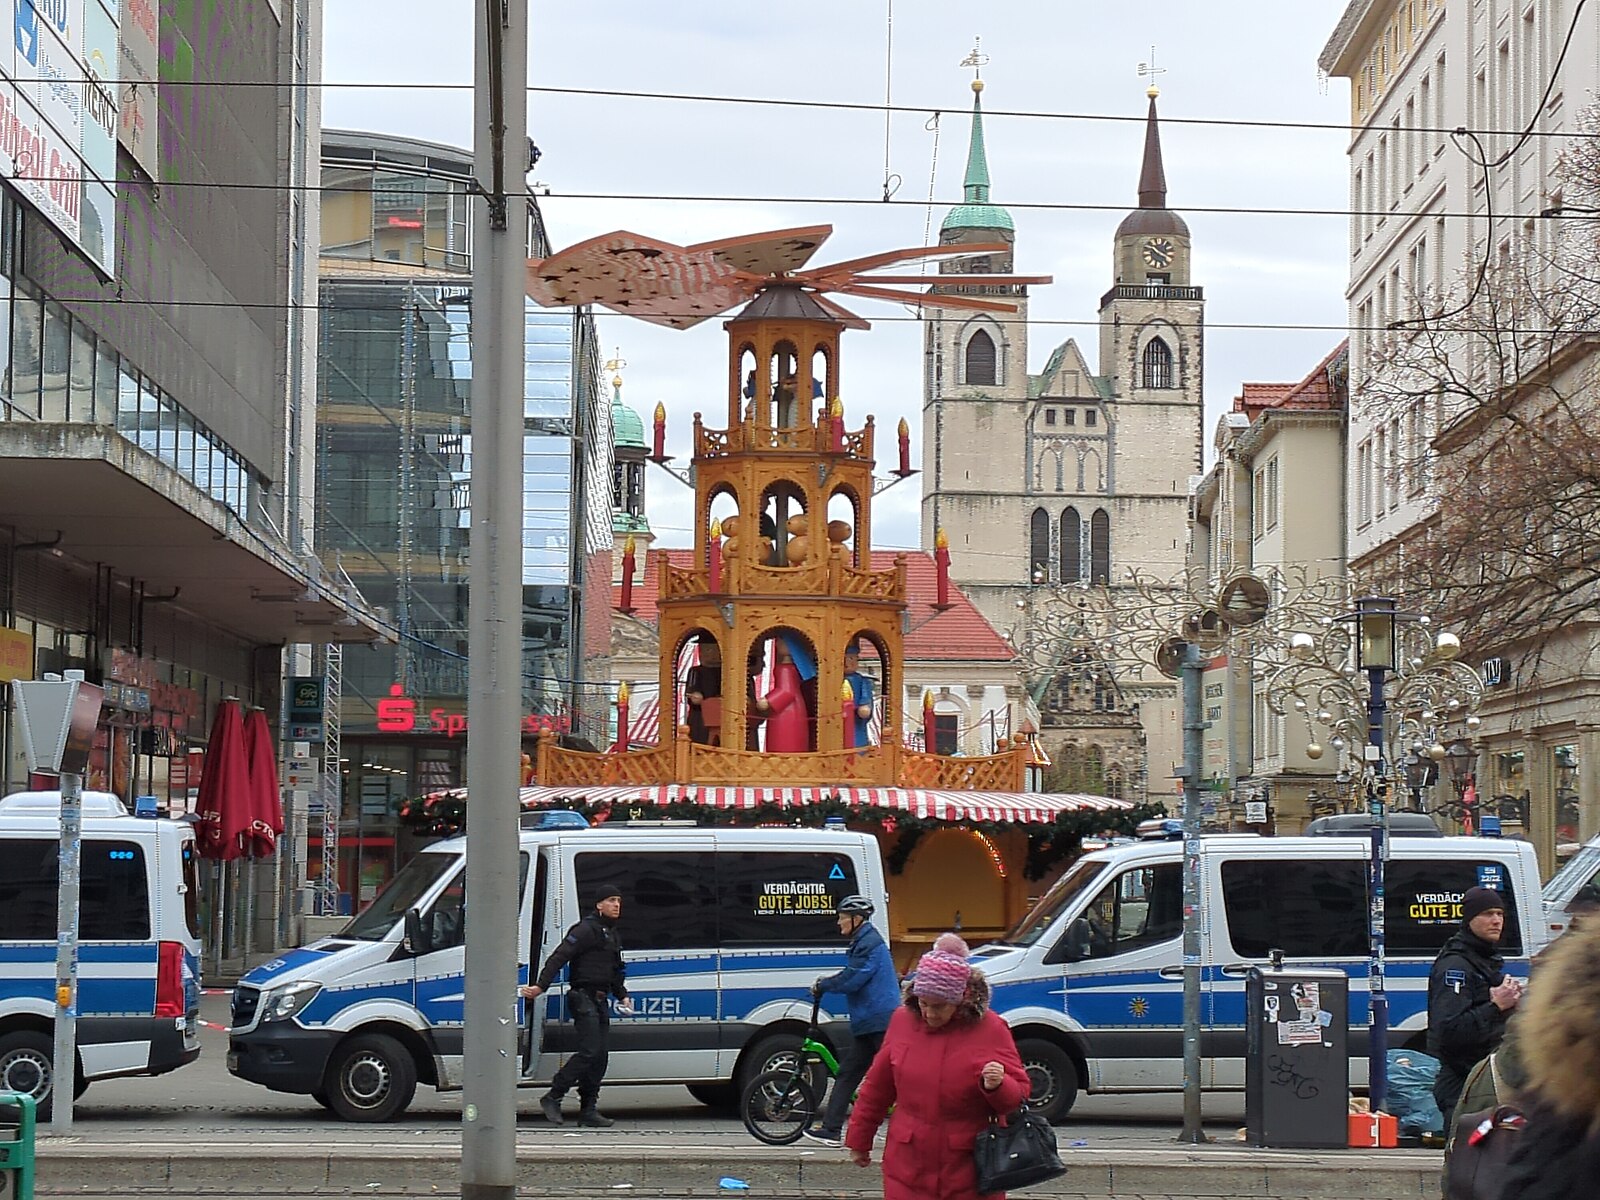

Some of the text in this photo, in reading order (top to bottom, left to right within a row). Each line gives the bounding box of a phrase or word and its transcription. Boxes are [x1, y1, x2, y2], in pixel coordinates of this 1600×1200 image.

[764, 881, 826, 894] VERDÄCHTIG
[758, 895, 792, 910] GUTE
[1410, 904, 1447, 918] GUTE
